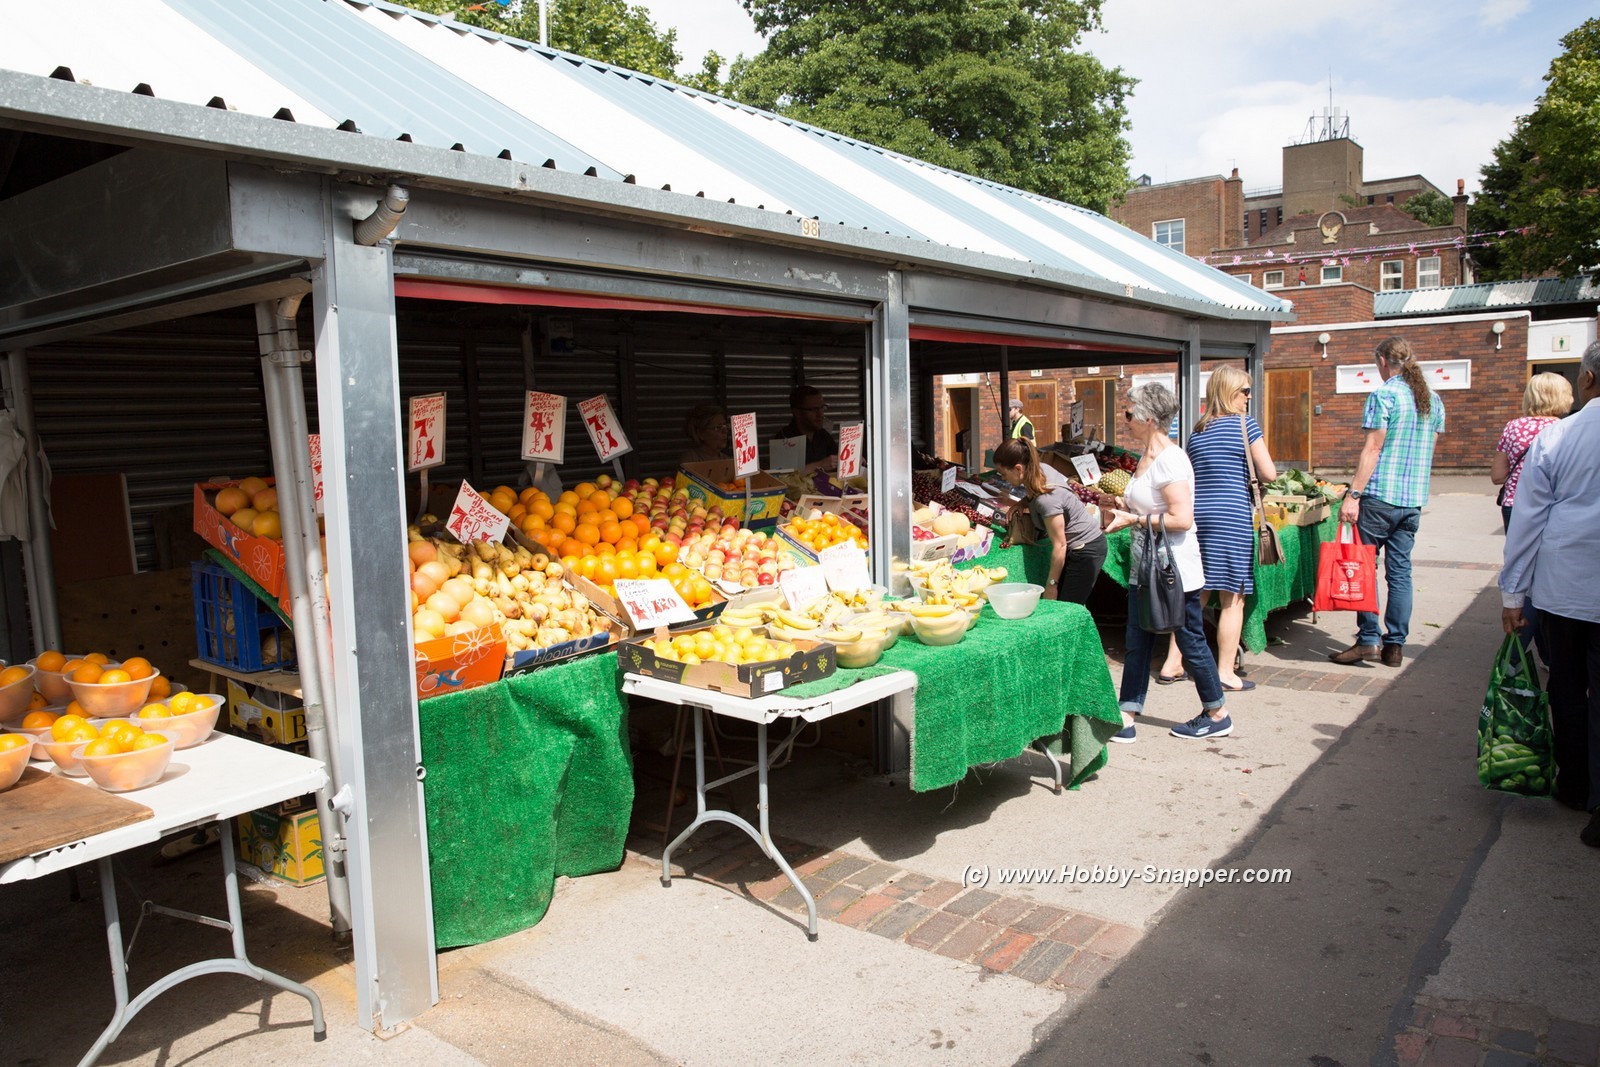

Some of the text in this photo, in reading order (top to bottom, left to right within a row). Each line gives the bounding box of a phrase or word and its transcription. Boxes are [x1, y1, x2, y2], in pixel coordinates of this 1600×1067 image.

[803, 220, 818, 236] 98
[413, 418, 427, 438] 7
[587, 414, 604, 432] 7
[840, 443, 850, 461] 6
[463, 483, 483, 504] SOUTH
[450, 504, 468, 539] 7
[472, 500, 503, 523] AFRICAN
